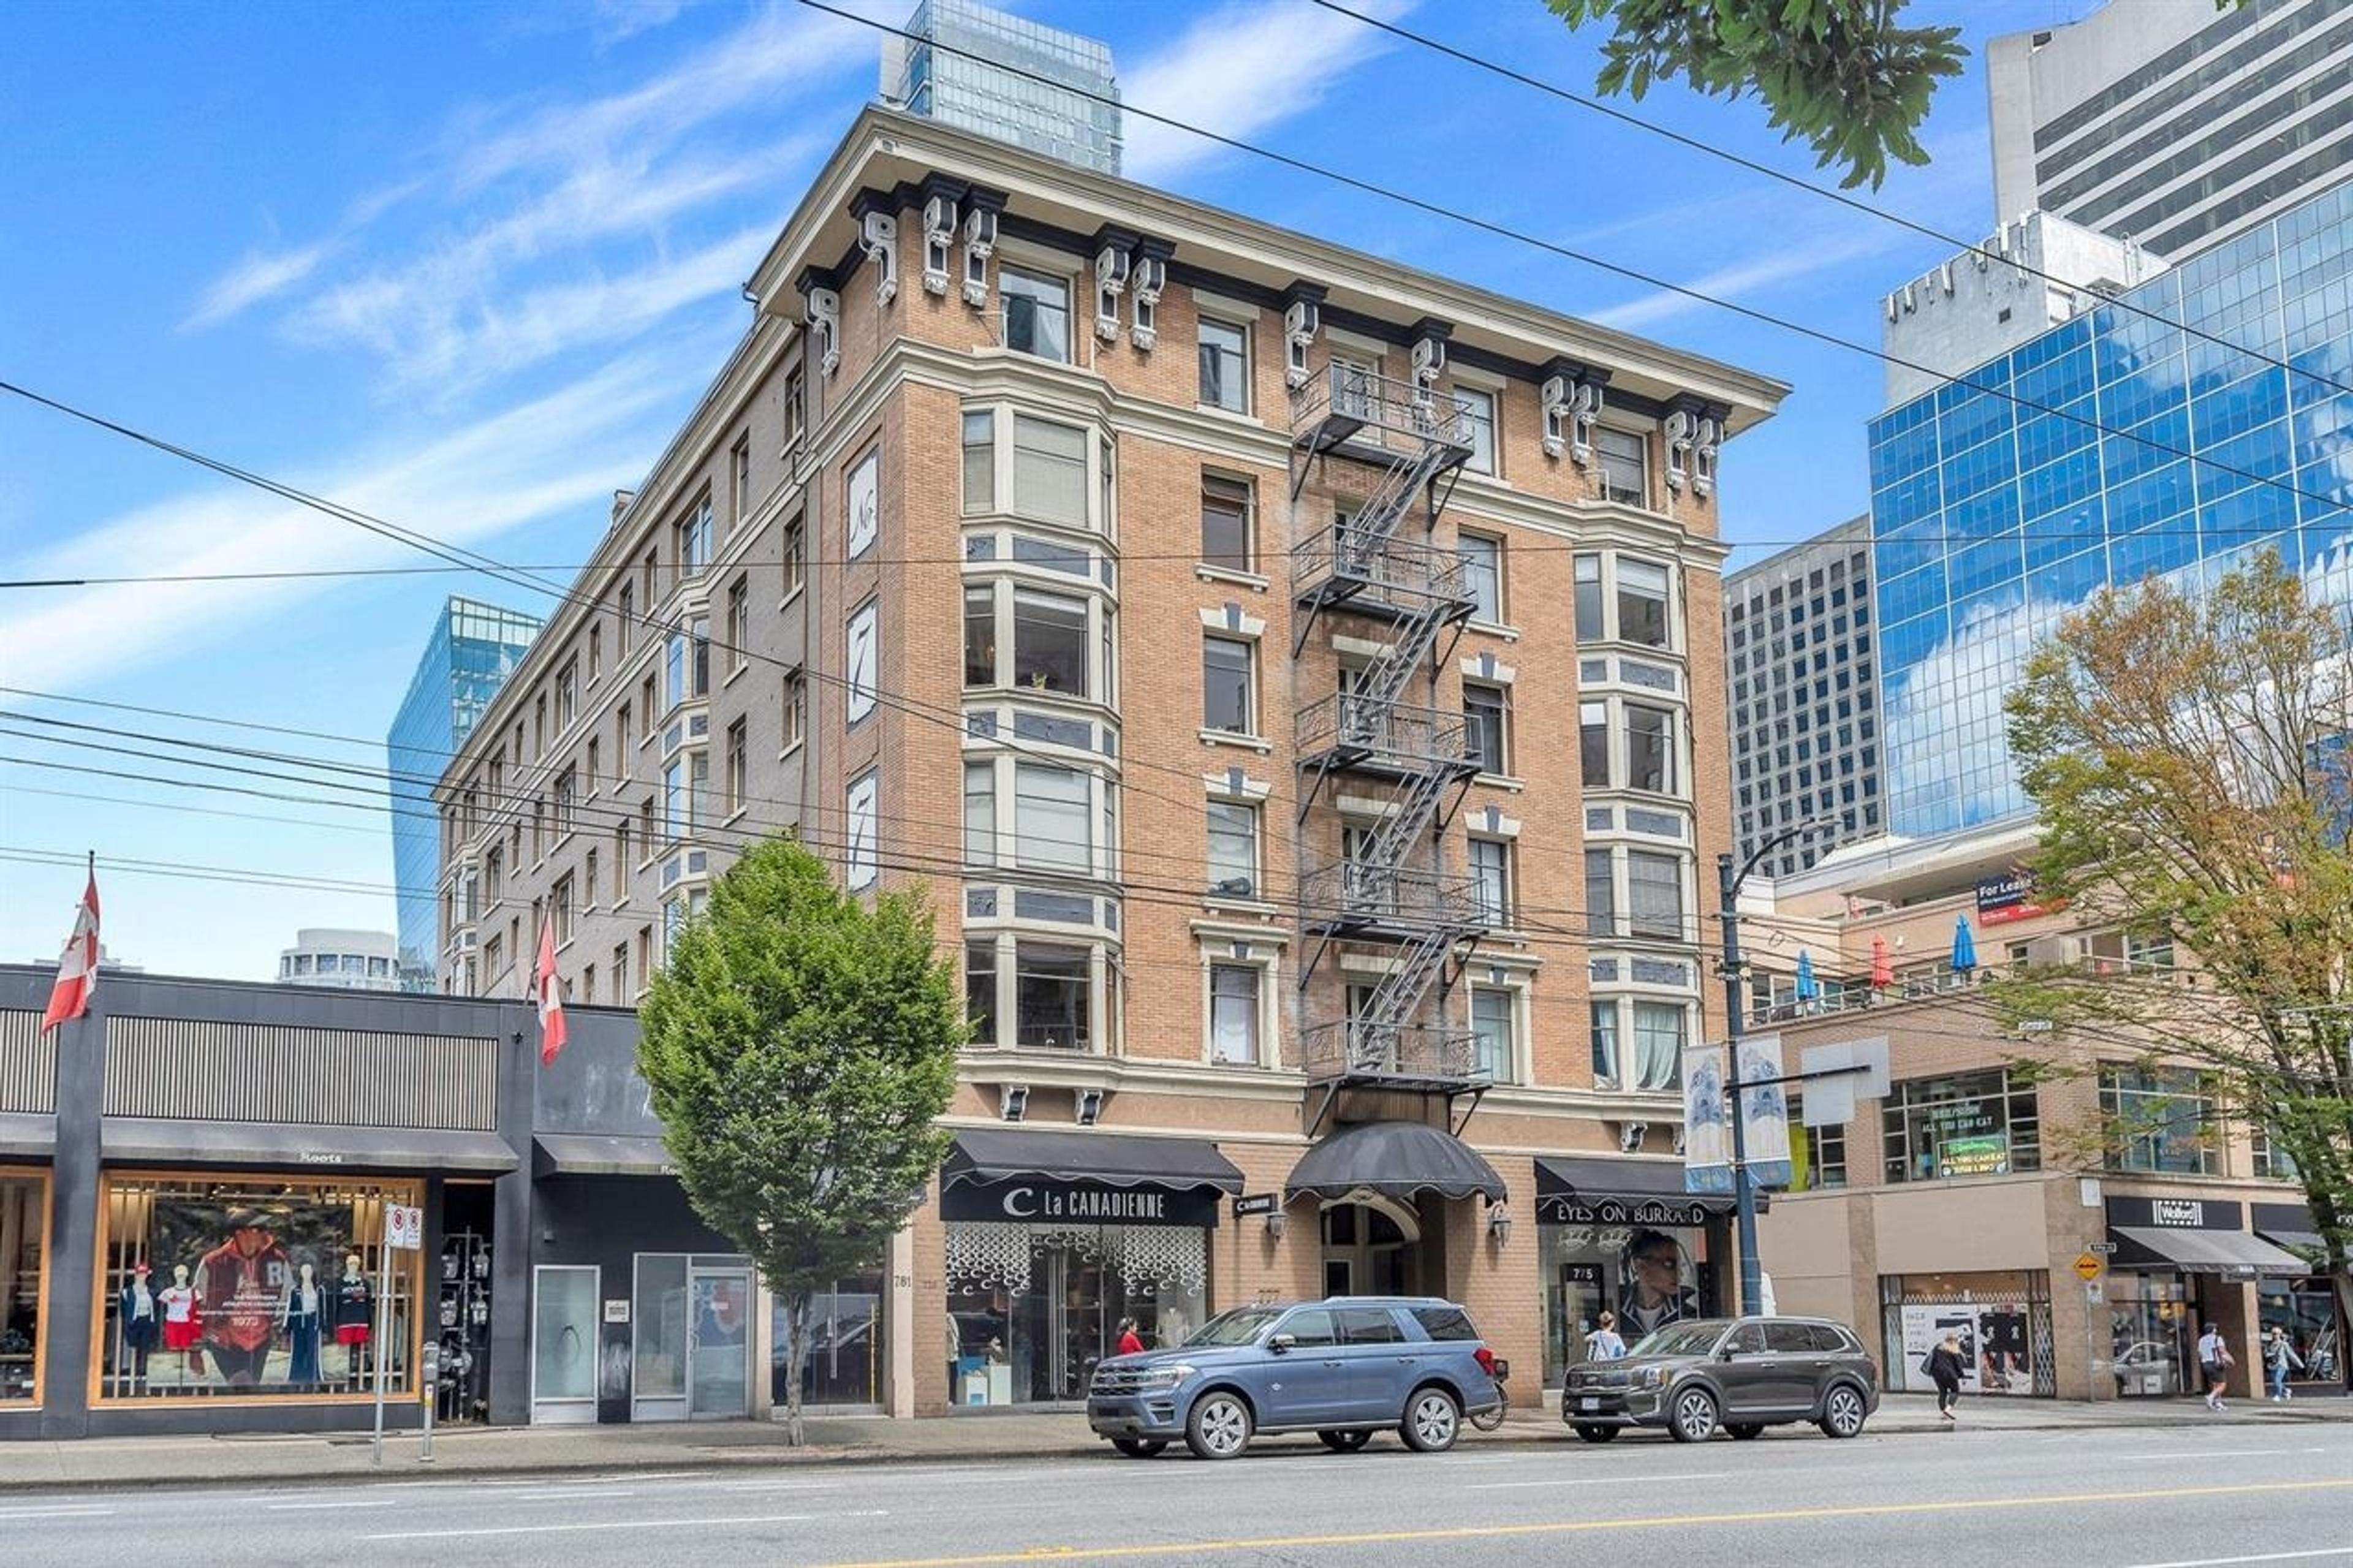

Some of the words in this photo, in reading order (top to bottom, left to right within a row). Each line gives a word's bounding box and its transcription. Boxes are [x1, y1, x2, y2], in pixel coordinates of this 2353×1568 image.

[1979, 885, 1998, 898] For
[1045, 1191, 1062, 1215] La
[1069, 1191, 1164, 1218] CANADIENNE
[1558, 1204, 1593, 1221] EYES
[1602, 1205, 1626, 1222] ON
[1634, 1208, 1703, 1224] BURRAD
[267, 1262, 284, 1286] R
